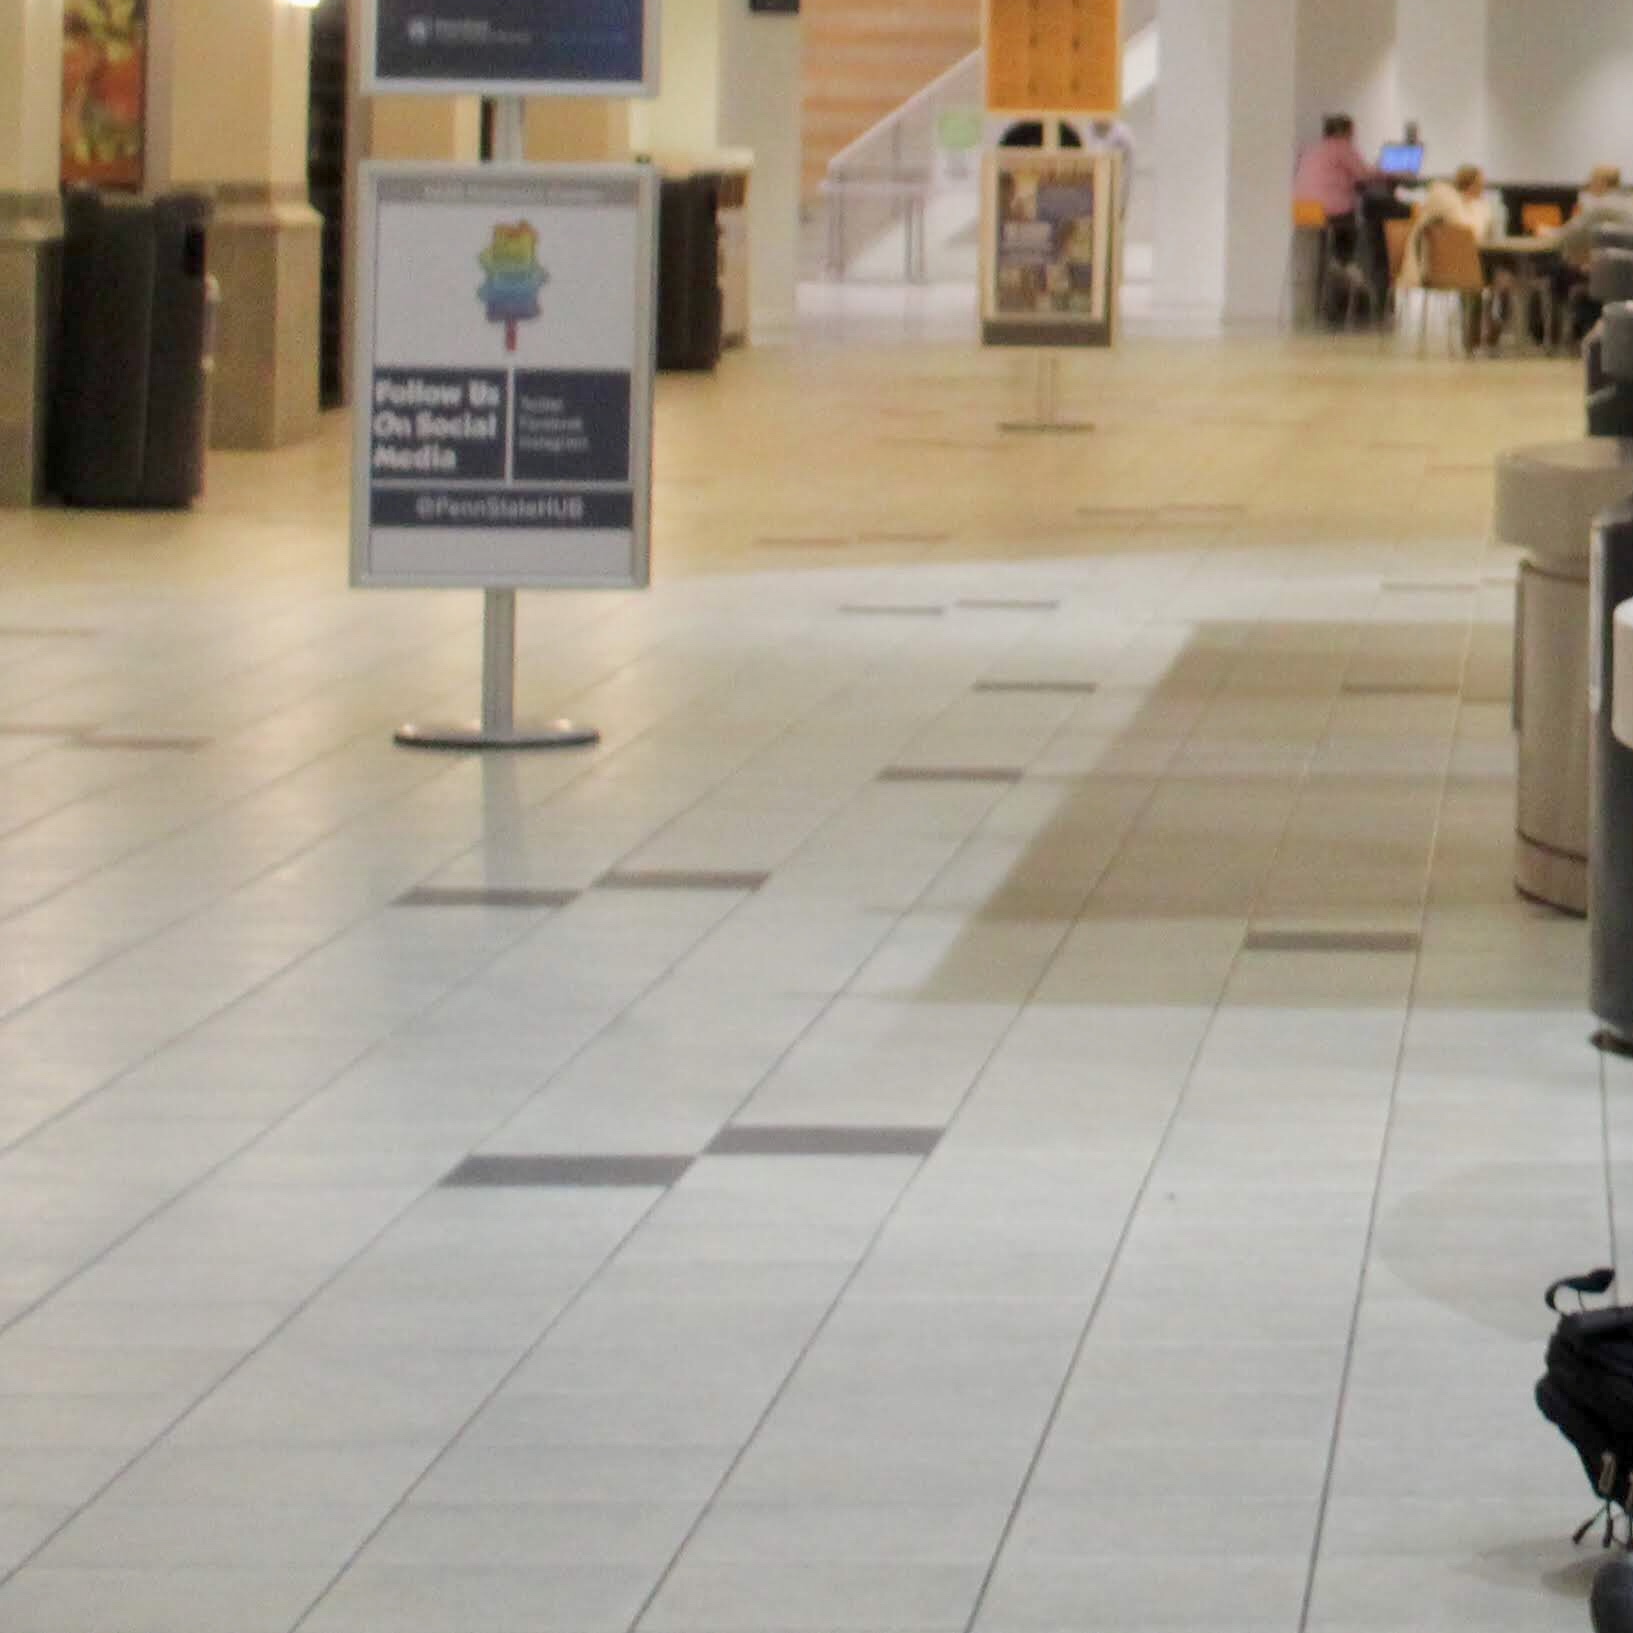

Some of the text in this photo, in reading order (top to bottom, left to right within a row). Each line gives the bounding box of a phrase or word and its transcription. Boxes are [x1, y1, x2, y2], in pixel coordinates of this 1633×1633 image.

[375, 380, 499, 406] Follow Us
[374, 411, 496, 439] On Social
[373, 445, 456, 470] Media
[416, 496, 585, 519] @PennStateHUB
